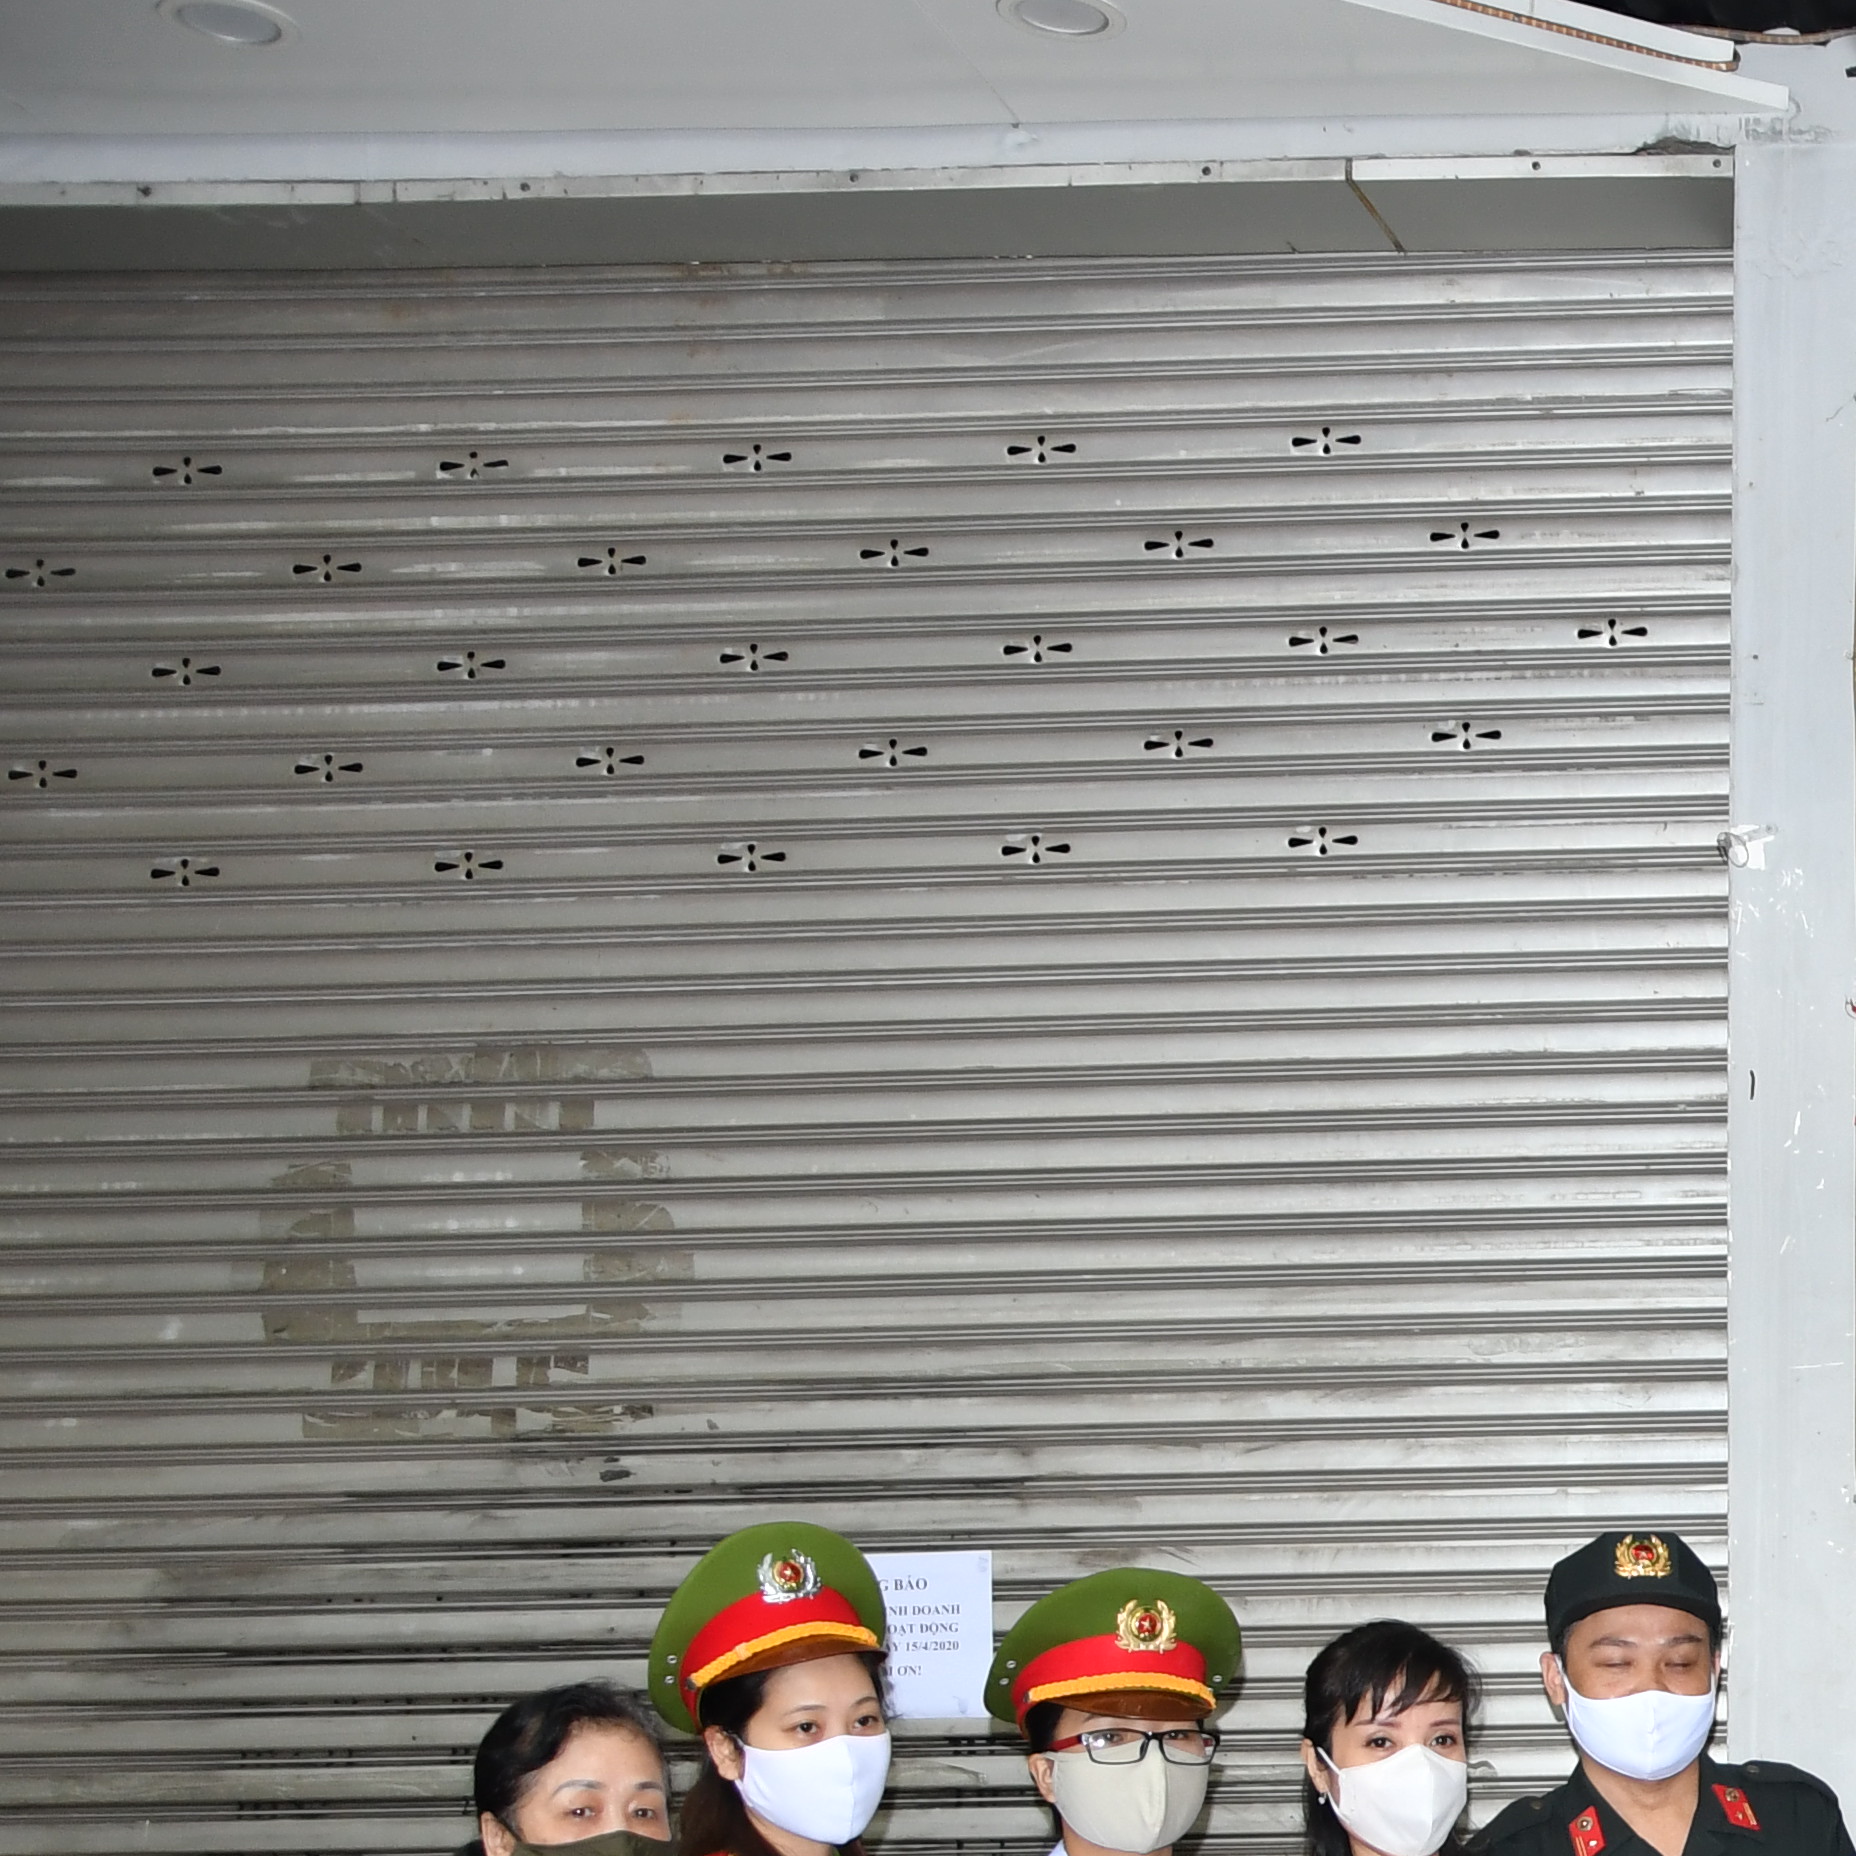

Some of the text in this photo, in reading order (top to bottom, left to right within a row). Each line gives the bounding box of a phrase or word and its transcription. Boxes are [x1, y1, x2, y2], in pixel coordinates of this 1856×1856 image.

[888, 1604, 960, 1616] NH DOANH
[887, 1623, 915, 1636] OẠT
[906, 1640, 959, 1652] 15/4/2020
